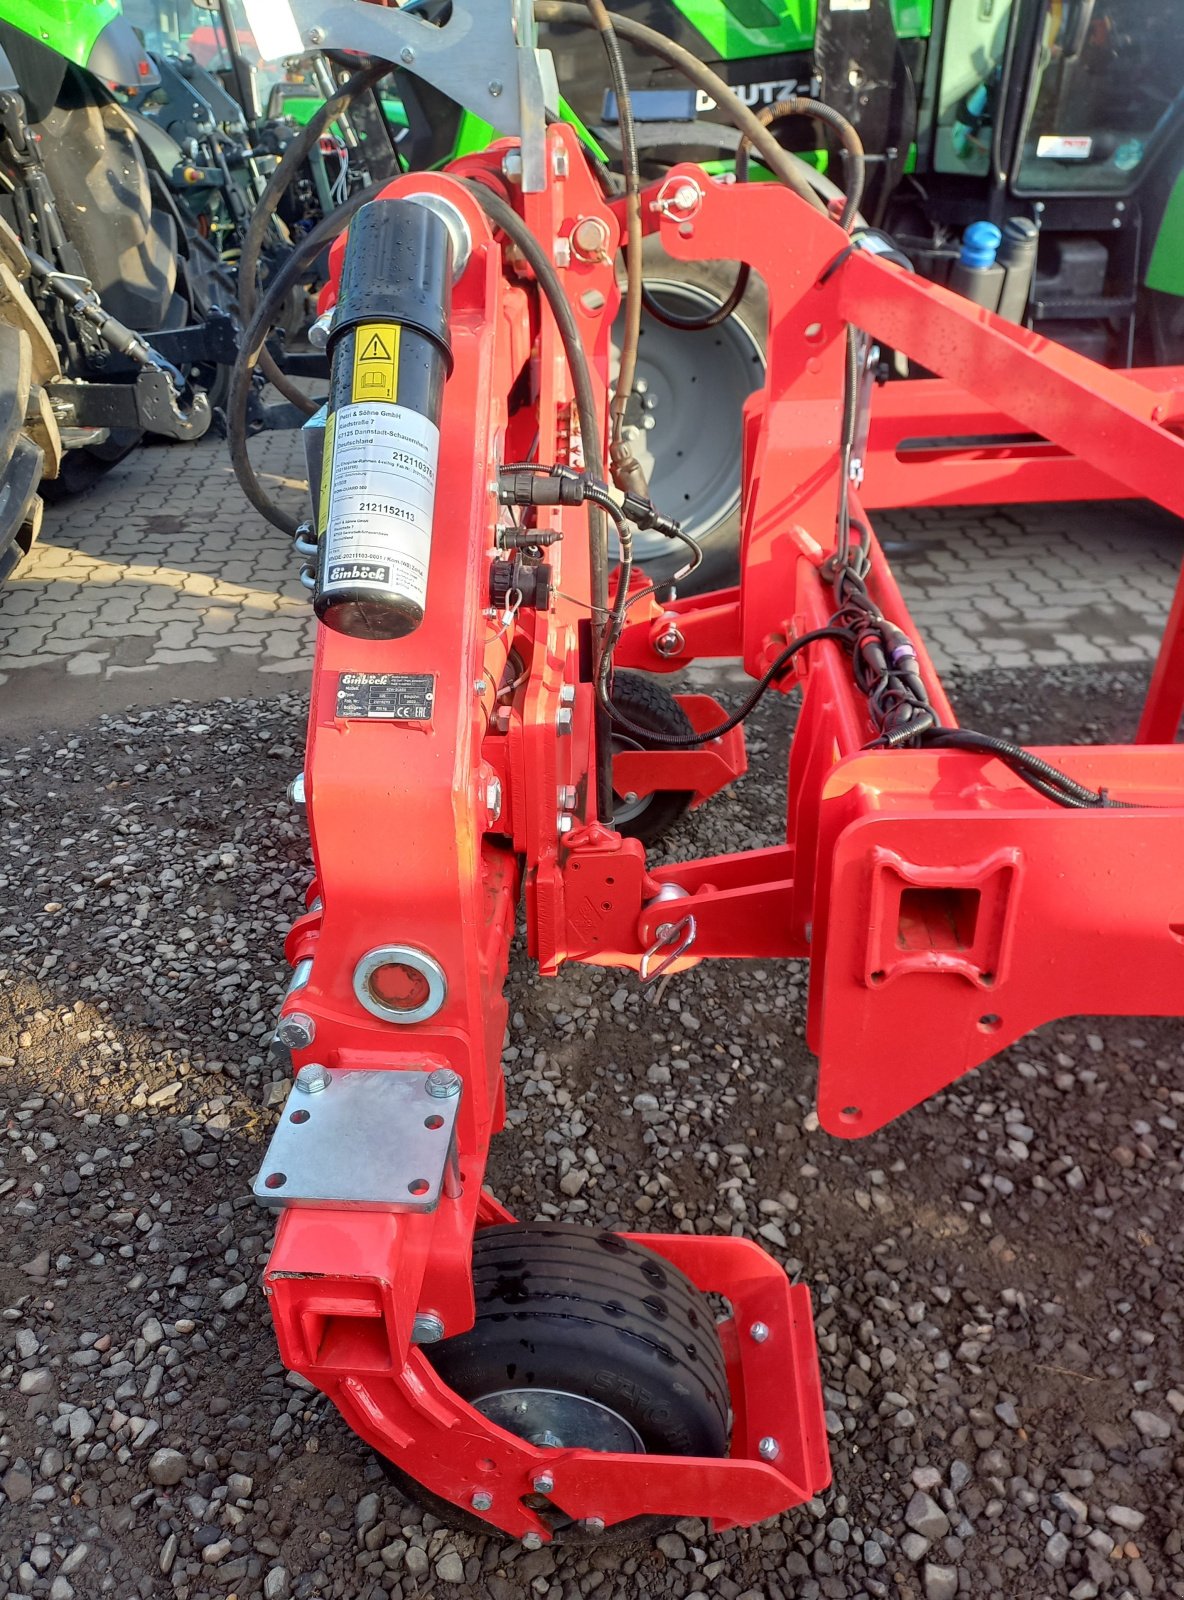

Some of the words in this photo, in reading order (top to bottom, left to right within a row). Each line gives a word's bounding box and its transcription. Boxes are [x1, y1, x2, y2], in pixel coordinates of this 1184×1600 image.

[381, 410, 401, 419] GmbH
[359, 502, 415, 522] 2121152113
[330, 565, 385, 581] Einböck
[342, 674, 388, 685] Einböck
